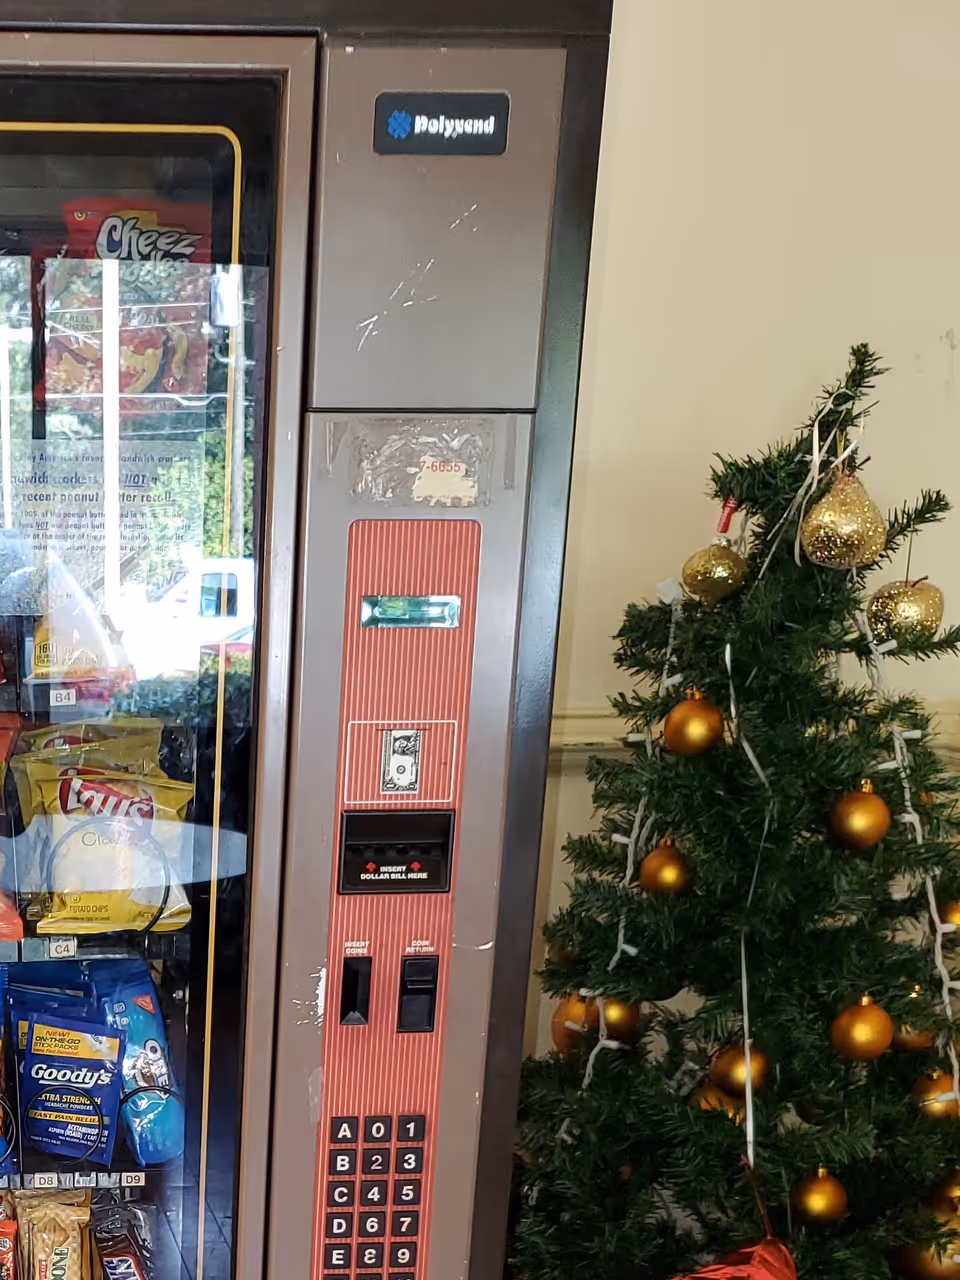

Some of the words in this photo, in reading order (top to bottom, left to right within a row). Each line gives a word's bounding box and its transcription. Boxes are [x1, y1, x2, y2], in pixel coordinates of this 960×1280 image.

[414, 115, 495, 138] Polyvend
[96, 215, 203, 260] Cheez
[22, 491, 56, 502] recent
[60, 492, 99, 505] peanut
[55, 692, 72, 703] B4
[360, 872, 390, 880] DOLLAR
[391, 872, 406, 880] BILL
[407, 871, 428, 879] HERE
[92, 905, 109, 913] CHIPS
[54, 944, 70, 954] C4
[344, 940, 370, 948] INSERT
[345, 947, 368, 955] COINS
[406, 946, 434, 954] RETURN
[45, 1030, 70, 1038] NEW!
[35, 1035, 81, 1045] ON-THE-GO
[33, 1042, 53, 1050] STICK
[53, 1043, 79, 1051] PACKS
[31, 1062, 113, 1088] Goody's
[33, 1111, 52, 1119] FAST
[54, 1113, 73, 1121] PAIN
[338, 1124, 351, 1138] A
[372, 1124, 385, 1137] 0
[406, 1123, 415, 1136] 1
[337, 1156, 349, 1170] B
[371, 1156, 382, 1169] 2
[404, 1154, 416, 1168] 3
[38, 1176, 54, 1186] D8
[126, 1175, 141, 1185] D9
[334, 1187, 347, 1202] C
[367, 1187, 380, 1200] 4
[401, 1186, 414, 1200] 5
[333, 1219, 346, 1233] D
[366, 1218, 378, 1232] 6
[400, 1218, 412, 1231] 7
[332, 1250, 344, 1264] E
[364, 1249, 376, 1264] 8
[397, 1249, 410, 1263] 9
